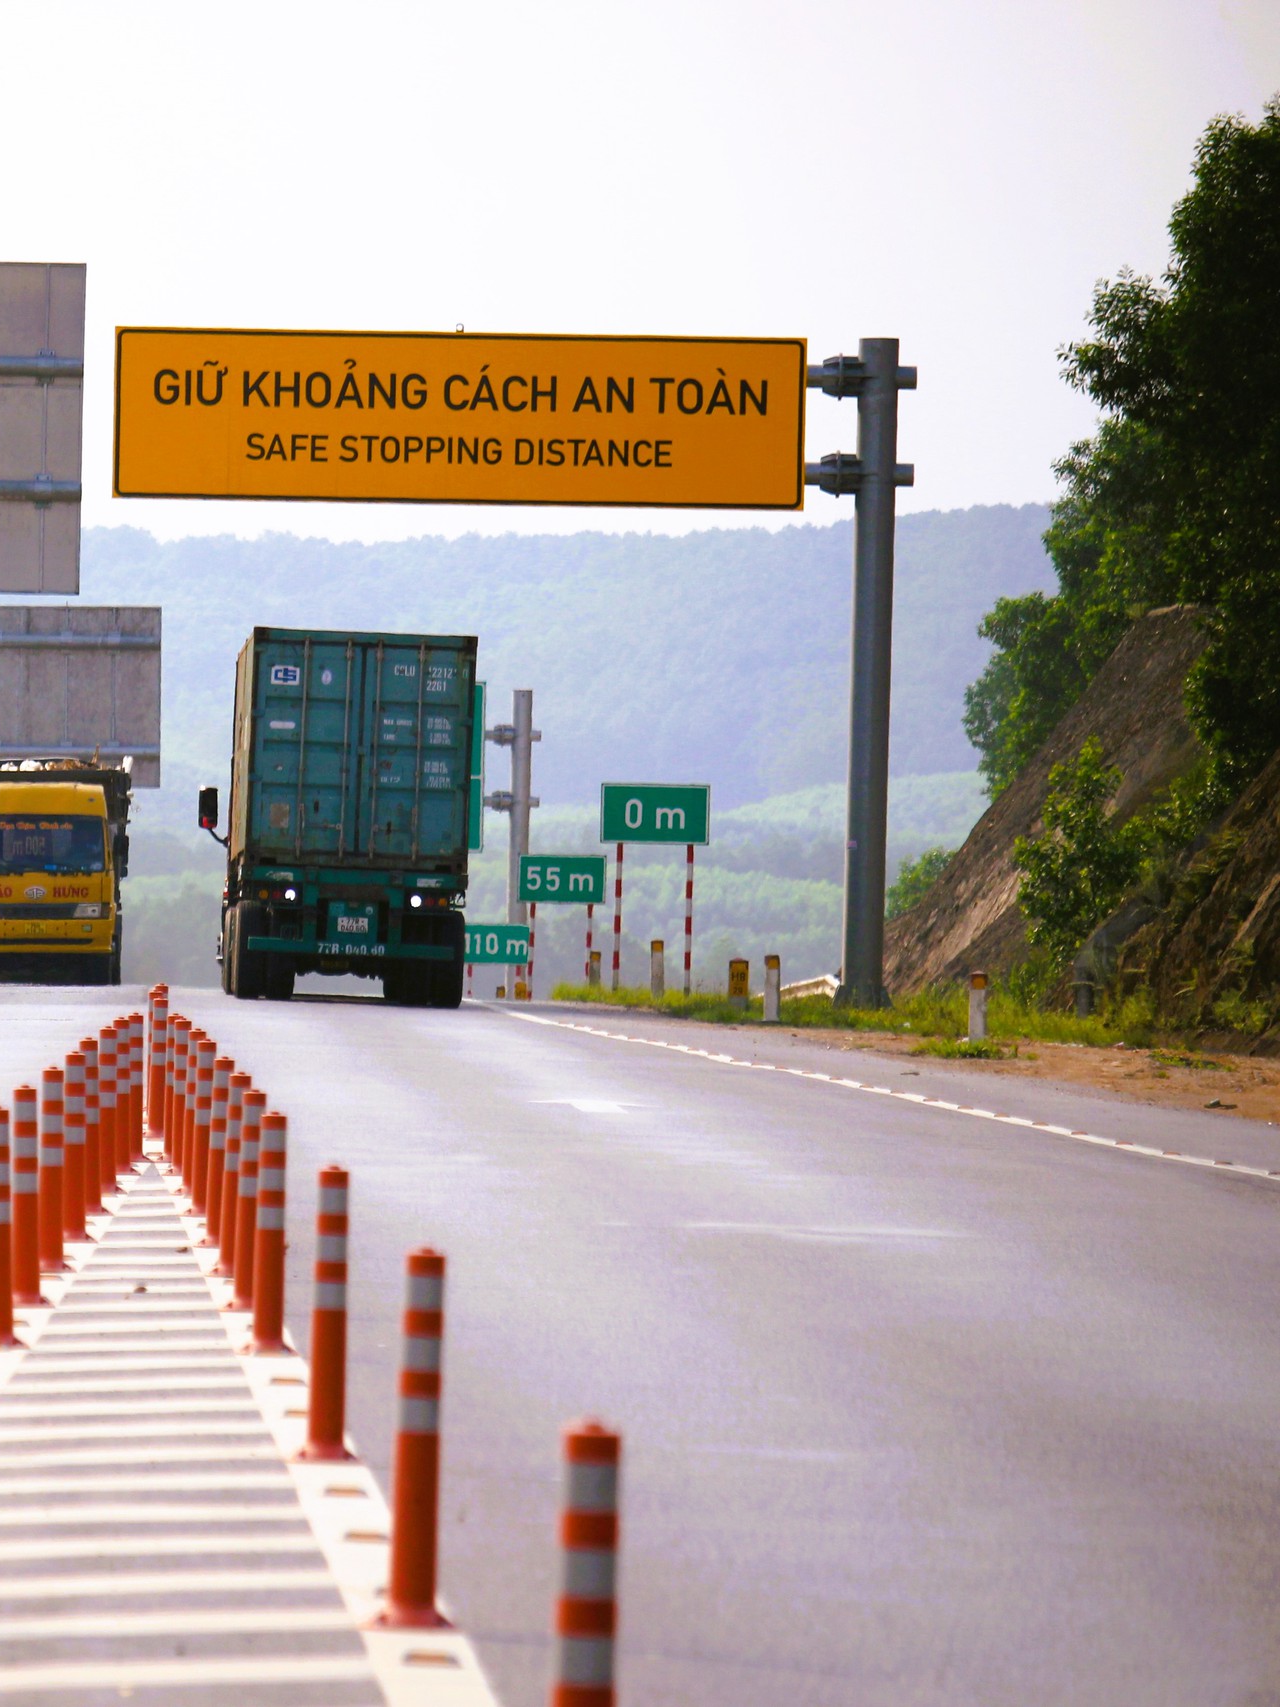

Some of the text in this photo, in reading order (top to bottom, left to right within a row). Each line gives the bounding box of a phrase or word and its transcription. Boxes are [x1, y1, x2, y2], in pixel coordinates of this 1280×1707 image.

[153, 358, 769, 417] GIỮ KHOẢNG CÁCH AN TOÀN
[245, 432, 673, 468] SAFE STOPPING DISTANCE
[624, 799, 685, 829] 0 m
[526, 866, 594, 892] 55 m
[464, 933, 528, 956] 110 m
